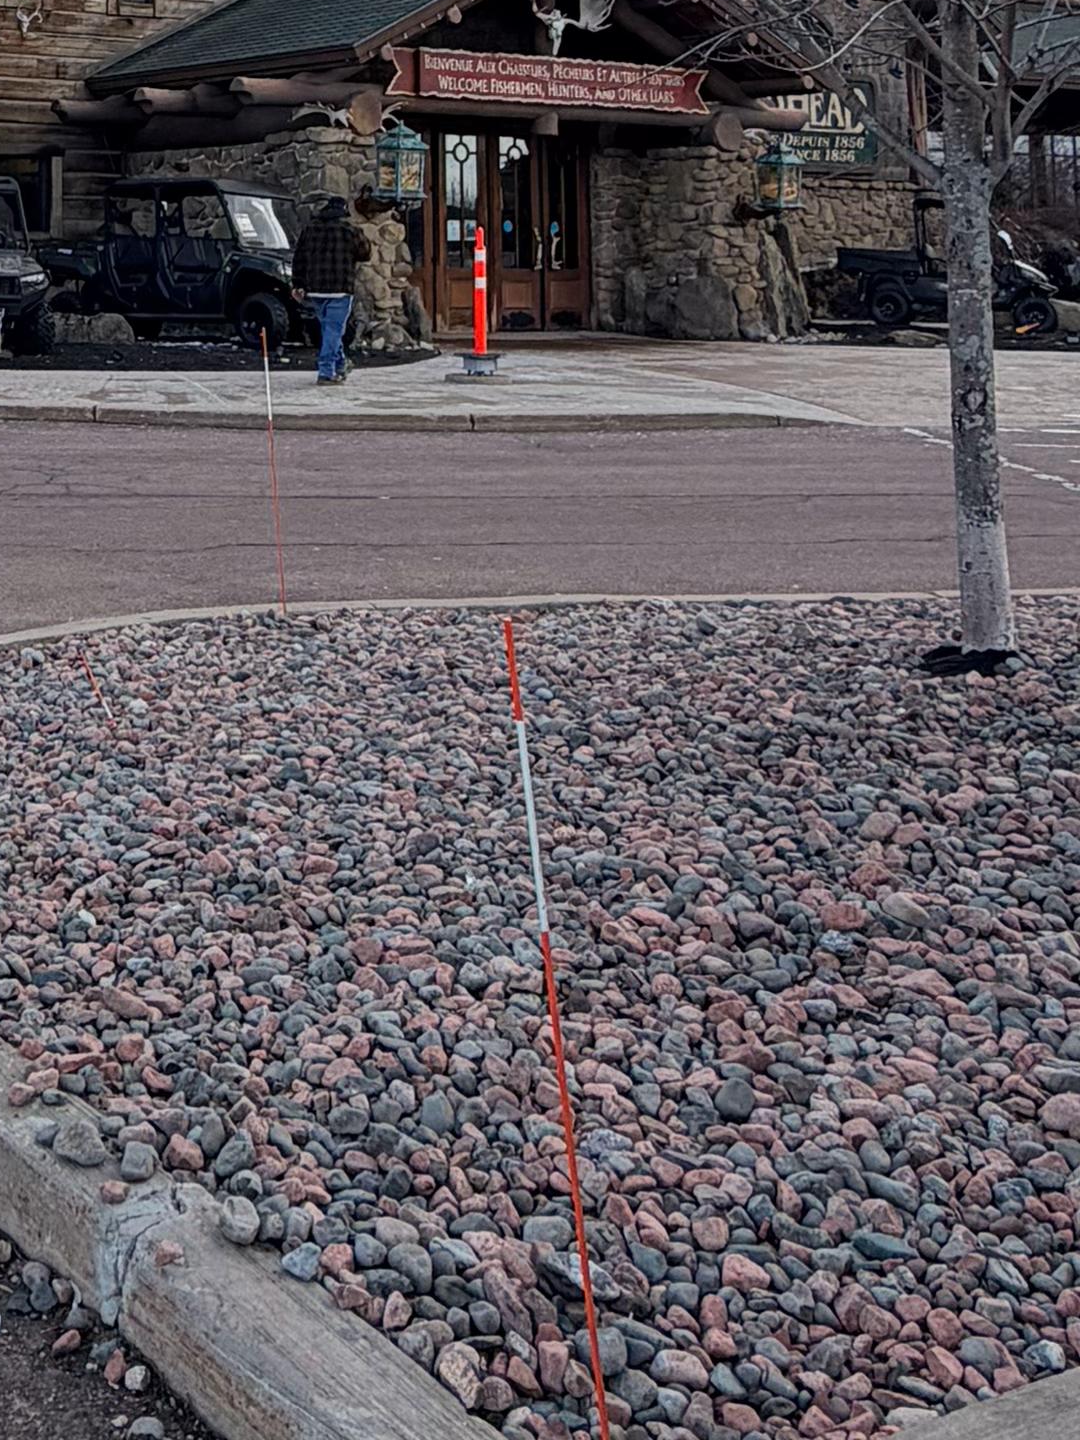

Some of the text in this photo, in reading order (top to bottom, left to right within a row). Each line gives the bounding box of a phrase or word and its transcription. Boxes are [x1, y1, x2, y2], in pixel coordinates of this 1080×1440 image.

[424, 54, 474, 73] BIENVENUE
[476, 59, 496, 74] AUX
[438, 74, 491, 93] WELCOME
[491, 78, 546, 98] FISHERMEN,
[618, 88, 648, 102] OTHER
[834, 135, 866, 149] 1856
[824, 148, 856, 162] 1856
